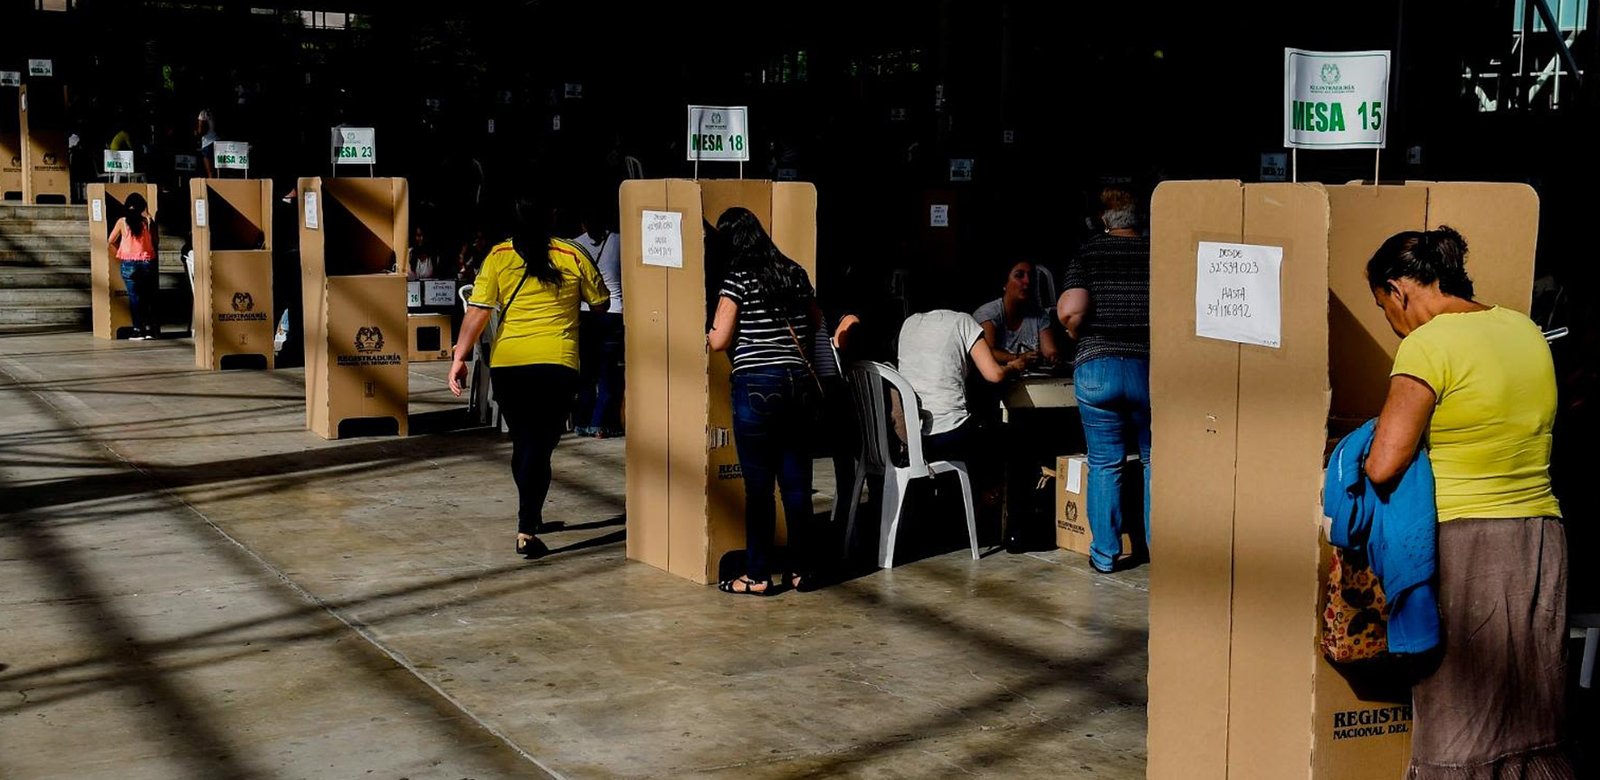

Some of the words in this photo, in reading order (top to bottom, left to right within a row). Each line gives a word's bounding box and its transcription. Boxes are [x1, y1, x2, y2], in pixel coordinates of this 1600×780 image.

[1293, 100, 1346, 132] MESA
[1357, 101, 1382, 131] 15
[692, 133, 724, 152] MESA
[728, 134, 743, 151] 18
[334, 146, 358, 158] MESA
[361, 146, 372, 158] 23
[106, 160, 123, 169] MESA
[217, 154, 236, 164] MESA
[238, 155, 248, 165] 26
[1219, 248, 1243, 259] DESDE
[1221, 286, 1246, 301] HASTA
[1333, 726, 1386, 740] NACIONAL
[1388, 723, 1410, 734] DEL
